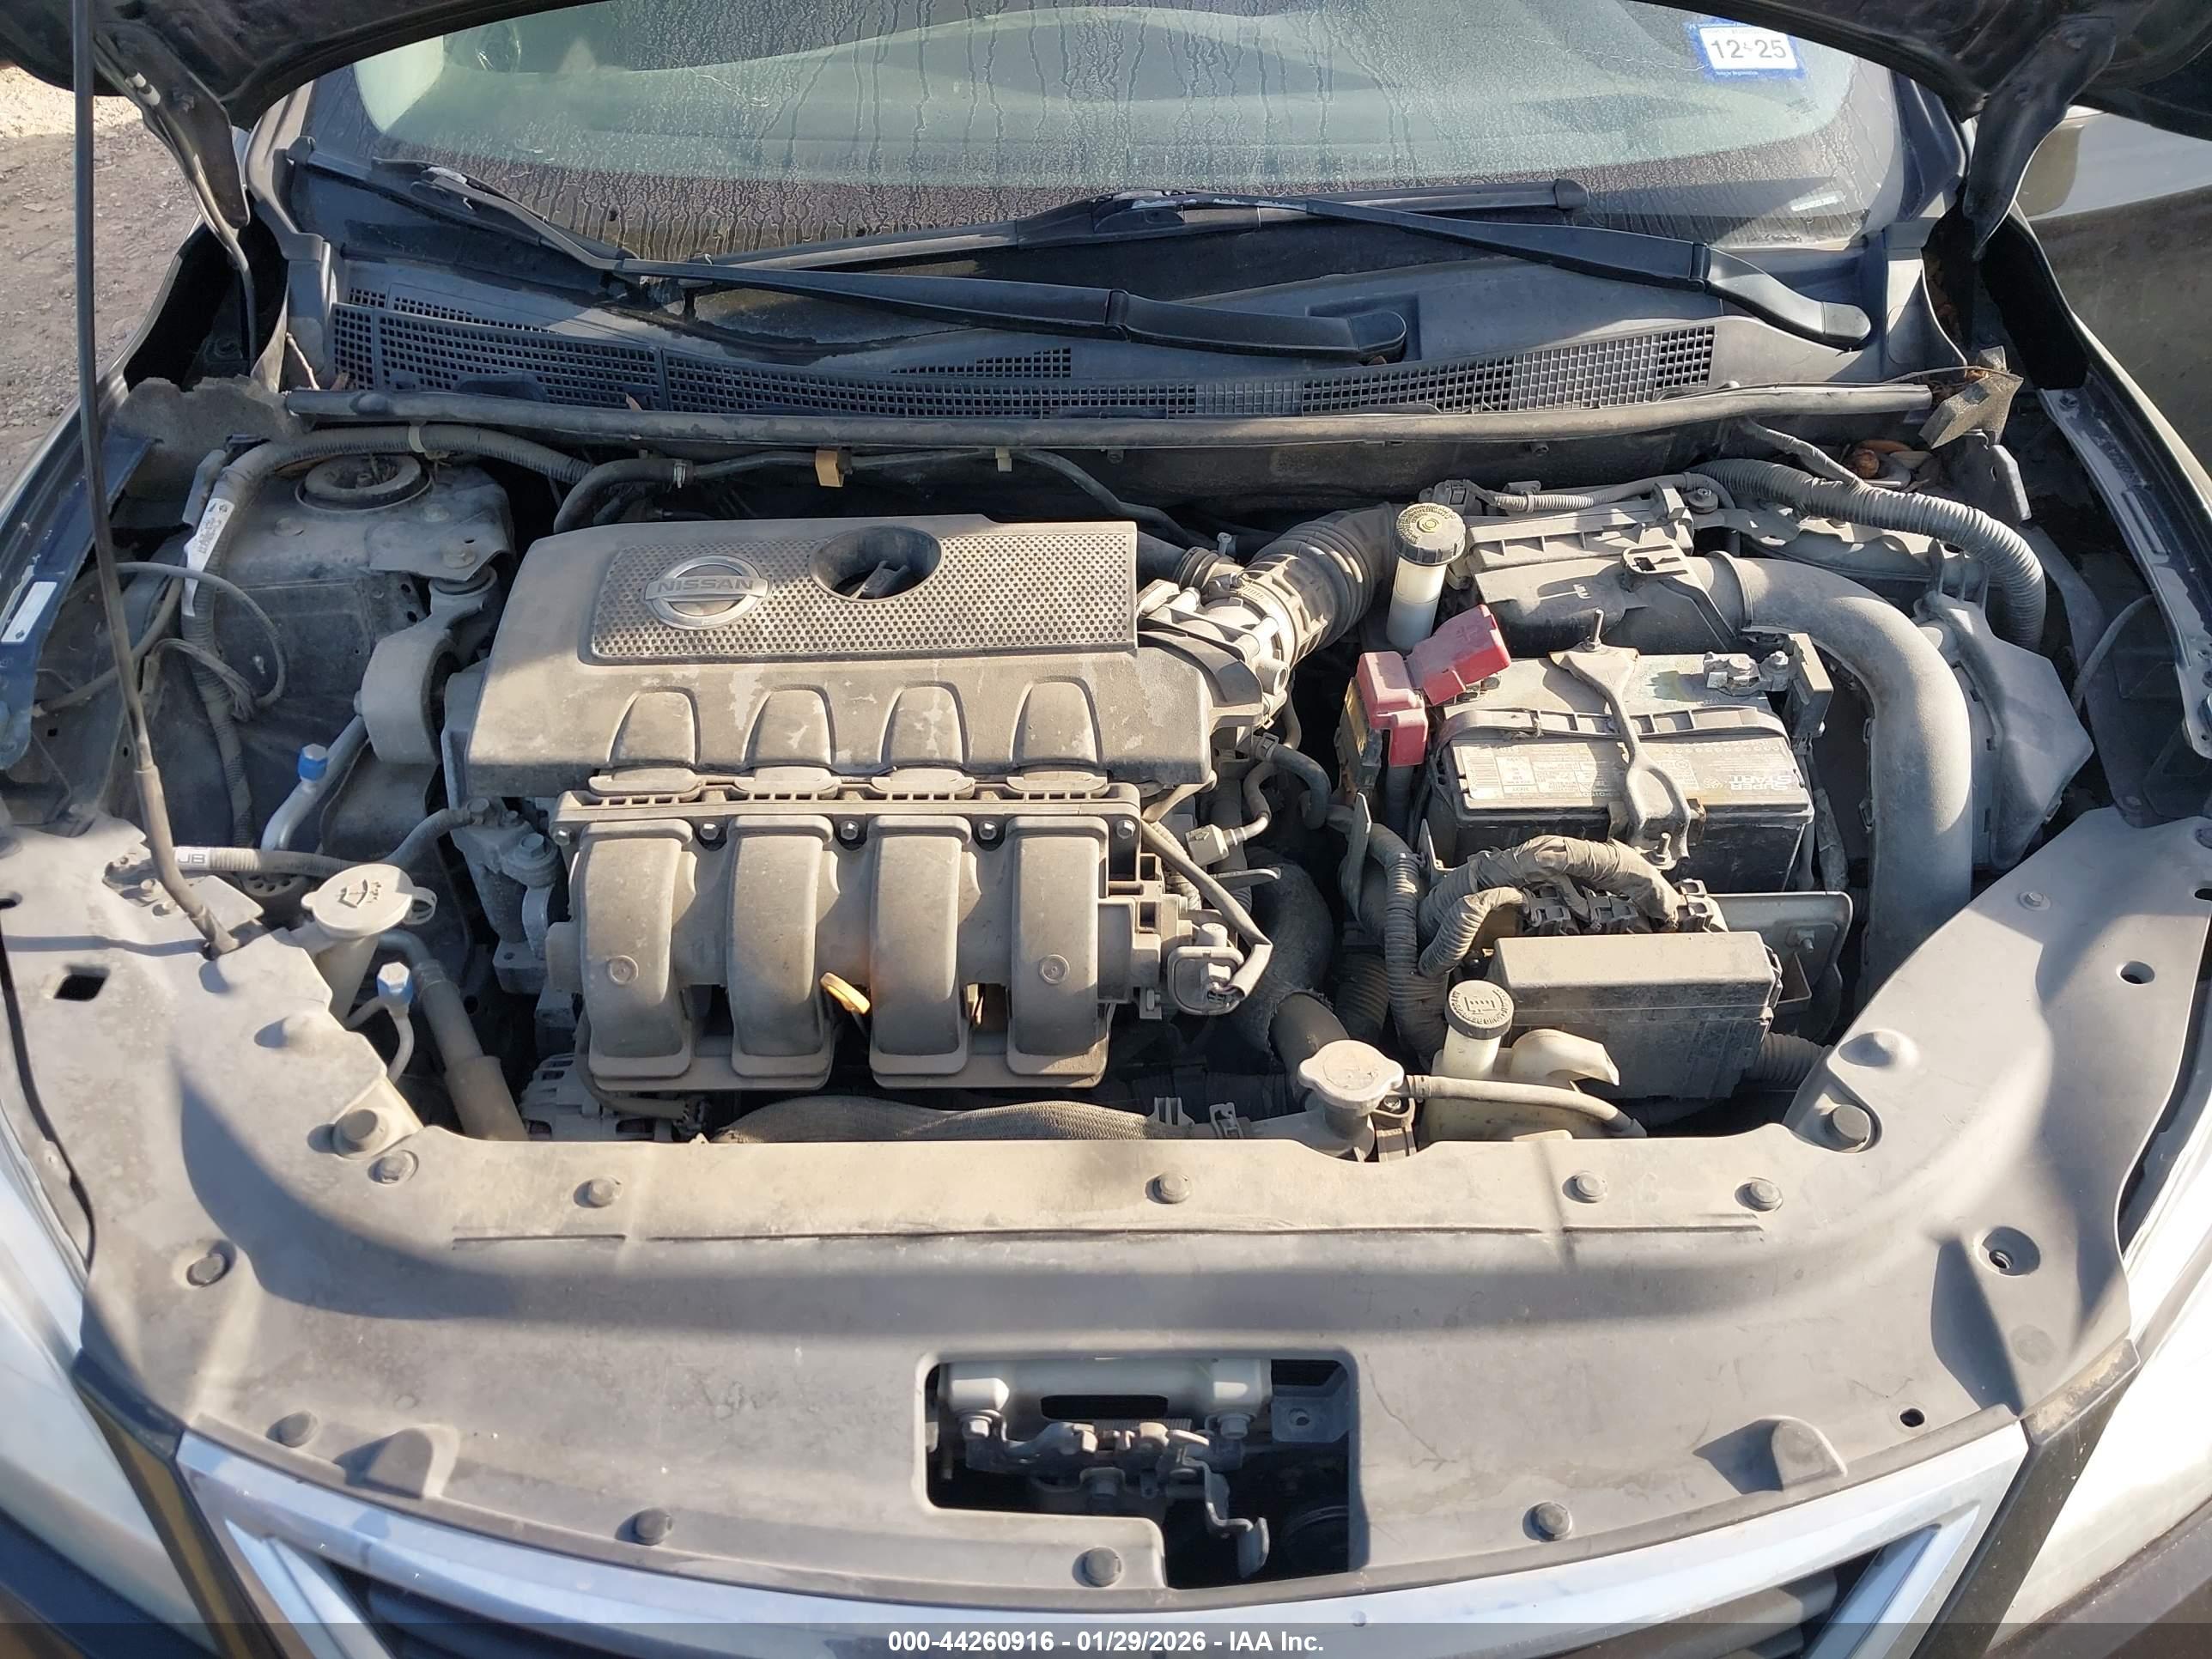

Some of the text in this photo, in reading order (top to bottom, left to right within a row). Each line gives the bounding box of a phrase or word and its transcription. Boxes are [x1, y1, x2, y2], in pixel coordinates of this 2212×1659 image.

[1711, 40, 1786, 58] 12 25
[657, 578, 754, 592] NISSAN
[1729, 775, 1792, 784] START
[1731, 781, 1789, 791] SUPER
